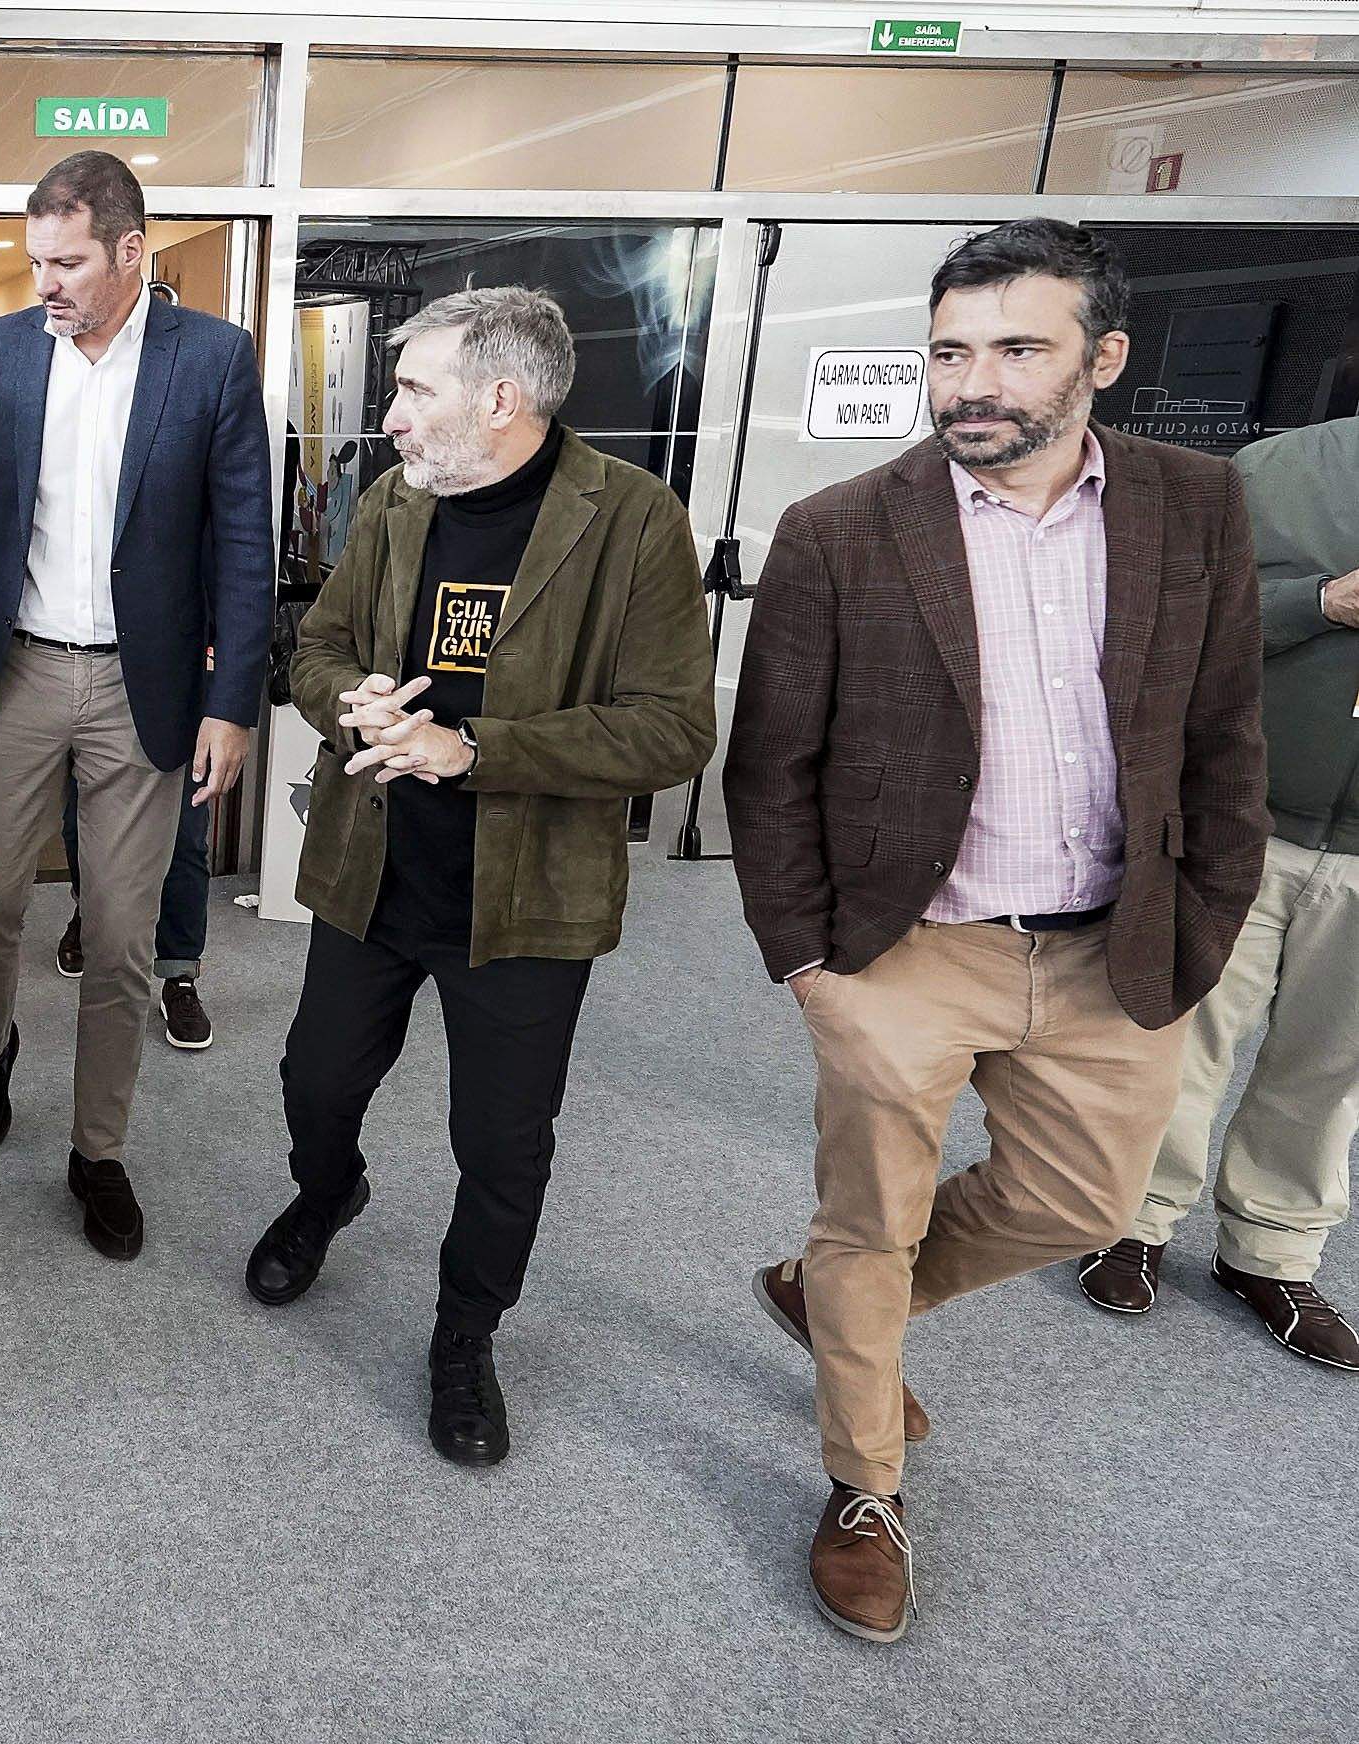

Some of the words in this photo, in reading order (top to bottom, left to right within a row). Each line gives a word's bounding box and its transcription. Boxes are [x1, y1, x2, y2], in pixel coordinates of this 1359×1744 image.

[914, 23, 942, 35] SAÍDA
[898, 37, 955, 47] EMERXENCIA
[53, 102, 151, 131] SAÍDA
[819, 364, 860, 386] ALARMA
[862, 364, 918, 386] CONECTADA
[836, 403, 859, 424] NON
[860, 403, 891, 424] PASEN
[447, 599, 493, 619] CUL
[446, 617, 492, 639] TUR
[441, 636, 488, 657] GAL
